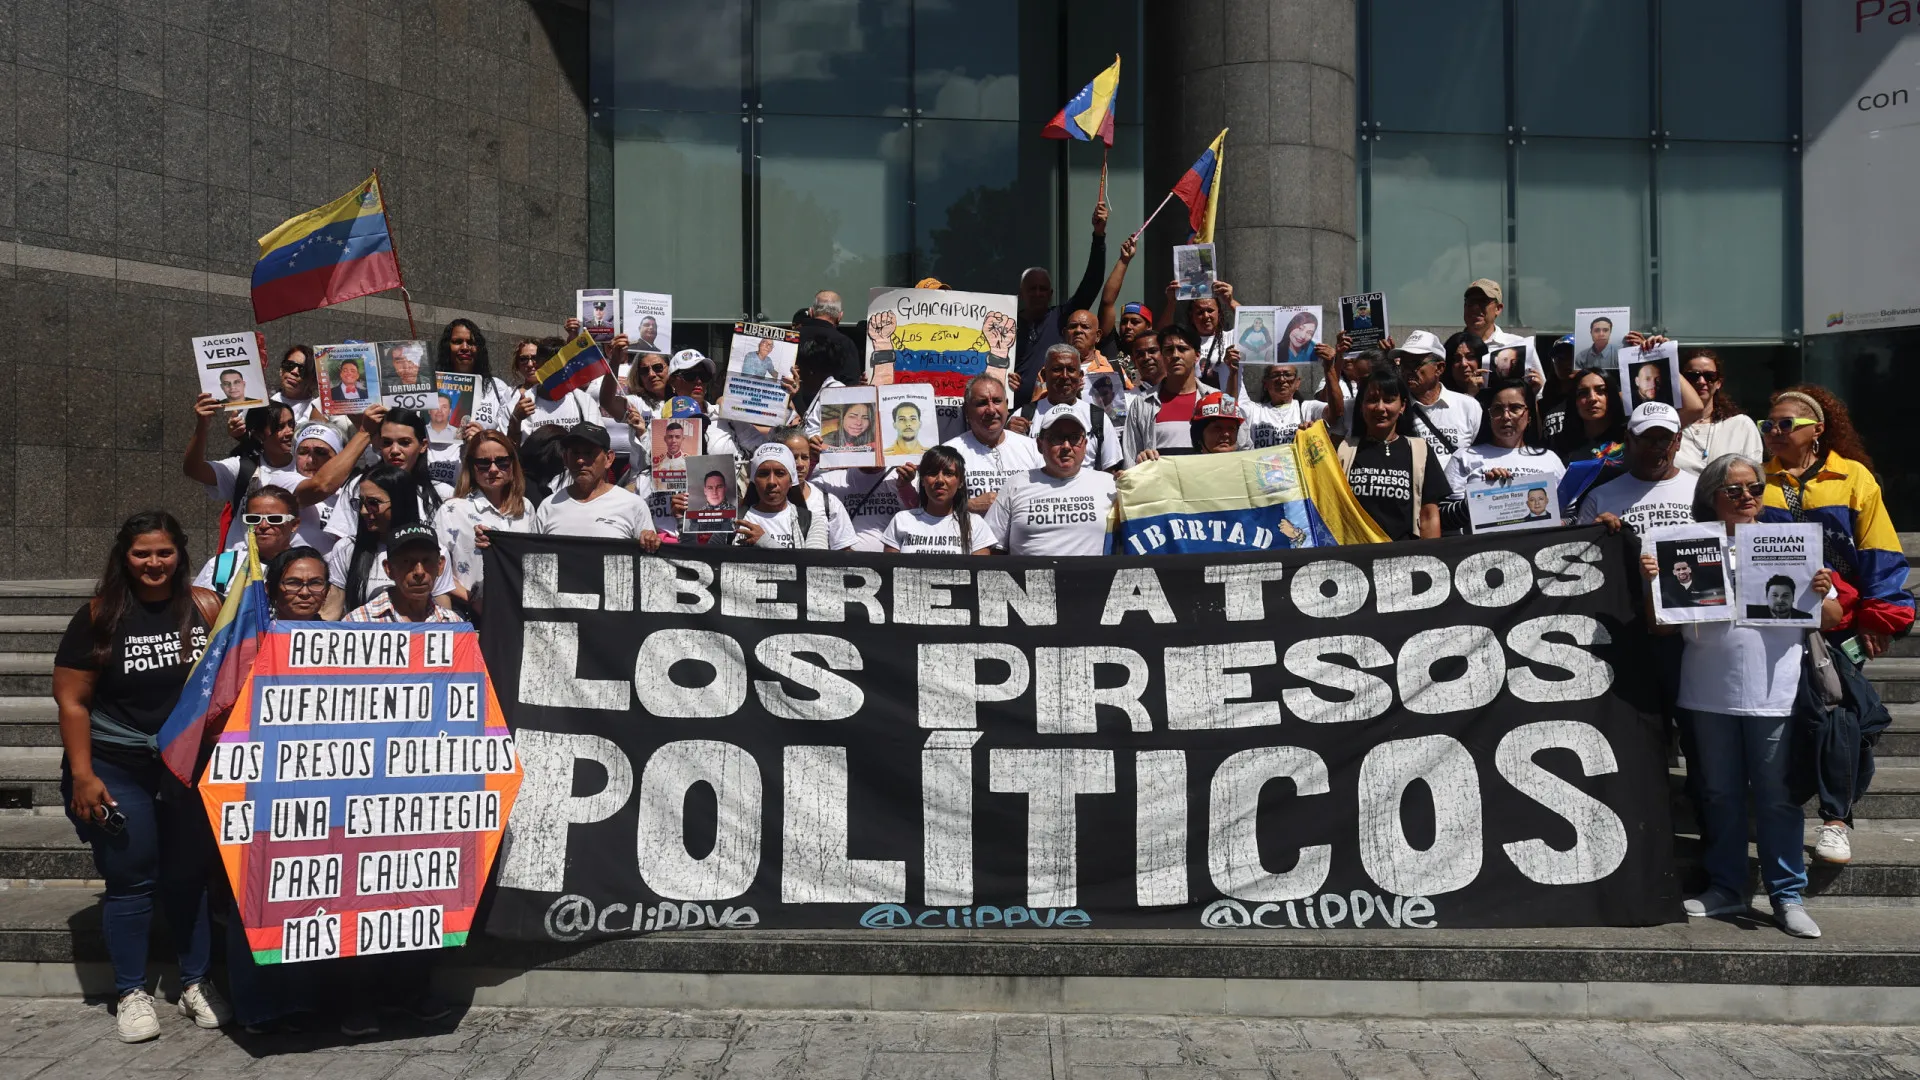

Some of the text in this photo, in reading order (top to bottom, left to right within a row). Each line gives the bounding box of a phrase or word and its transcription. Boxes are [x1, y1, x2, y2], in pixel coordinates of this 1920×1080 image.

[1856, 0, 1920, 33] Pa
[1857, 89, 1908, 111] con
[1342, 293, 1382, 305] LIBERTAD
[897, 297, 987, 321] GUAICAIPURO
[1880, 306, 1920, 317] Bolivarian
[743, 323, 787, 339] LIBERTAD
[901, 329, 923, 343] LOS
[202, 337, 244, 347] JACKSON
[203, 346, 248, 360] VERA
[388, 383, 432, 393] TORTURADO
[436, 382, 473, 393] BERTAD!
[393, 393, 428, 409] SOS
[1255, 430, 1270, 439] LOS
[433, 461, 456, 471] TODOS
[1350, 467, 1379, 475] LIBEREN
[1388, 469, 1410, 479] TODOS
[967, 478, 986, 487] LOS
[1349, 475, 1411, 488] LOS PRESOS
[1069, 495, 1095, 503] TODOS
[1028, 502, 1095, 513] LOS PRESOS
[1621, 504, 1657, 515] LIBEREN
[1027, 511, 1097, 525] POLÍTICOS
[394, 526, 434, 539] SAMBIL
[1752, 534, 1805, 544] GERMÁN
[927, 534, 934, 545] A
[934, 535, 948, 546] LAS
[1676, 546, 1721, 557] NAHUEL
[1752, 545, 1805, 553] GIULIANI
[1696, 553, 1722, 563] GALLO
[521, 541, 1606, 628] LIBEREN A TODOS
[124, 634, 163, 645] LIBEREN
[165, 632, 173, 641] A
[124, 635, 208, 658] LOS PREOS
[291, 631, 451, 666] AGRAVAR EL
[518, 614, 1615, 734] LOS PRESOS
[262, 685, 476, 723] SUFRIMIENTO DE
[212, 731, 513, 781] LOS PRESOS POLÍTICOS
[224, 792, 498, 842] ES UNA ESTRATEGIA
[496, 720, 1629, 909] POLÍTICOS
[271, 850, 458, 899] PARA CAUSAR
[284, 907, 441, 960] MÁS DOLOR
